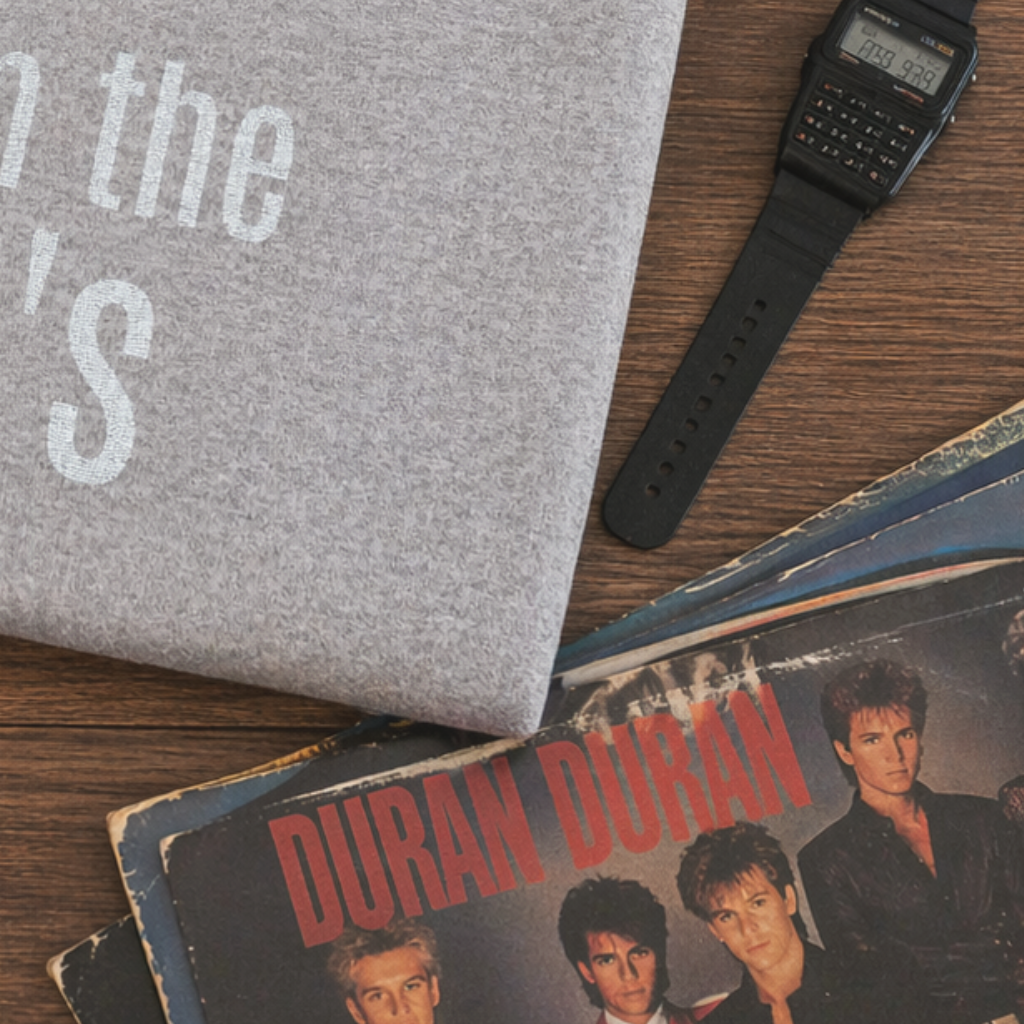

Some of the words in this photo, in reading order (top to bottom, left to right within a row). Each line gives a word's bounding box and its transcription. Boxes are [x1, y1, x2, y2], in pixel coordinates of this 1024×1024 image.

[88, 52, 294, 243] the
[268, 756, 546, 948] DURAN
[536, 683, 812, 871] DURAN
